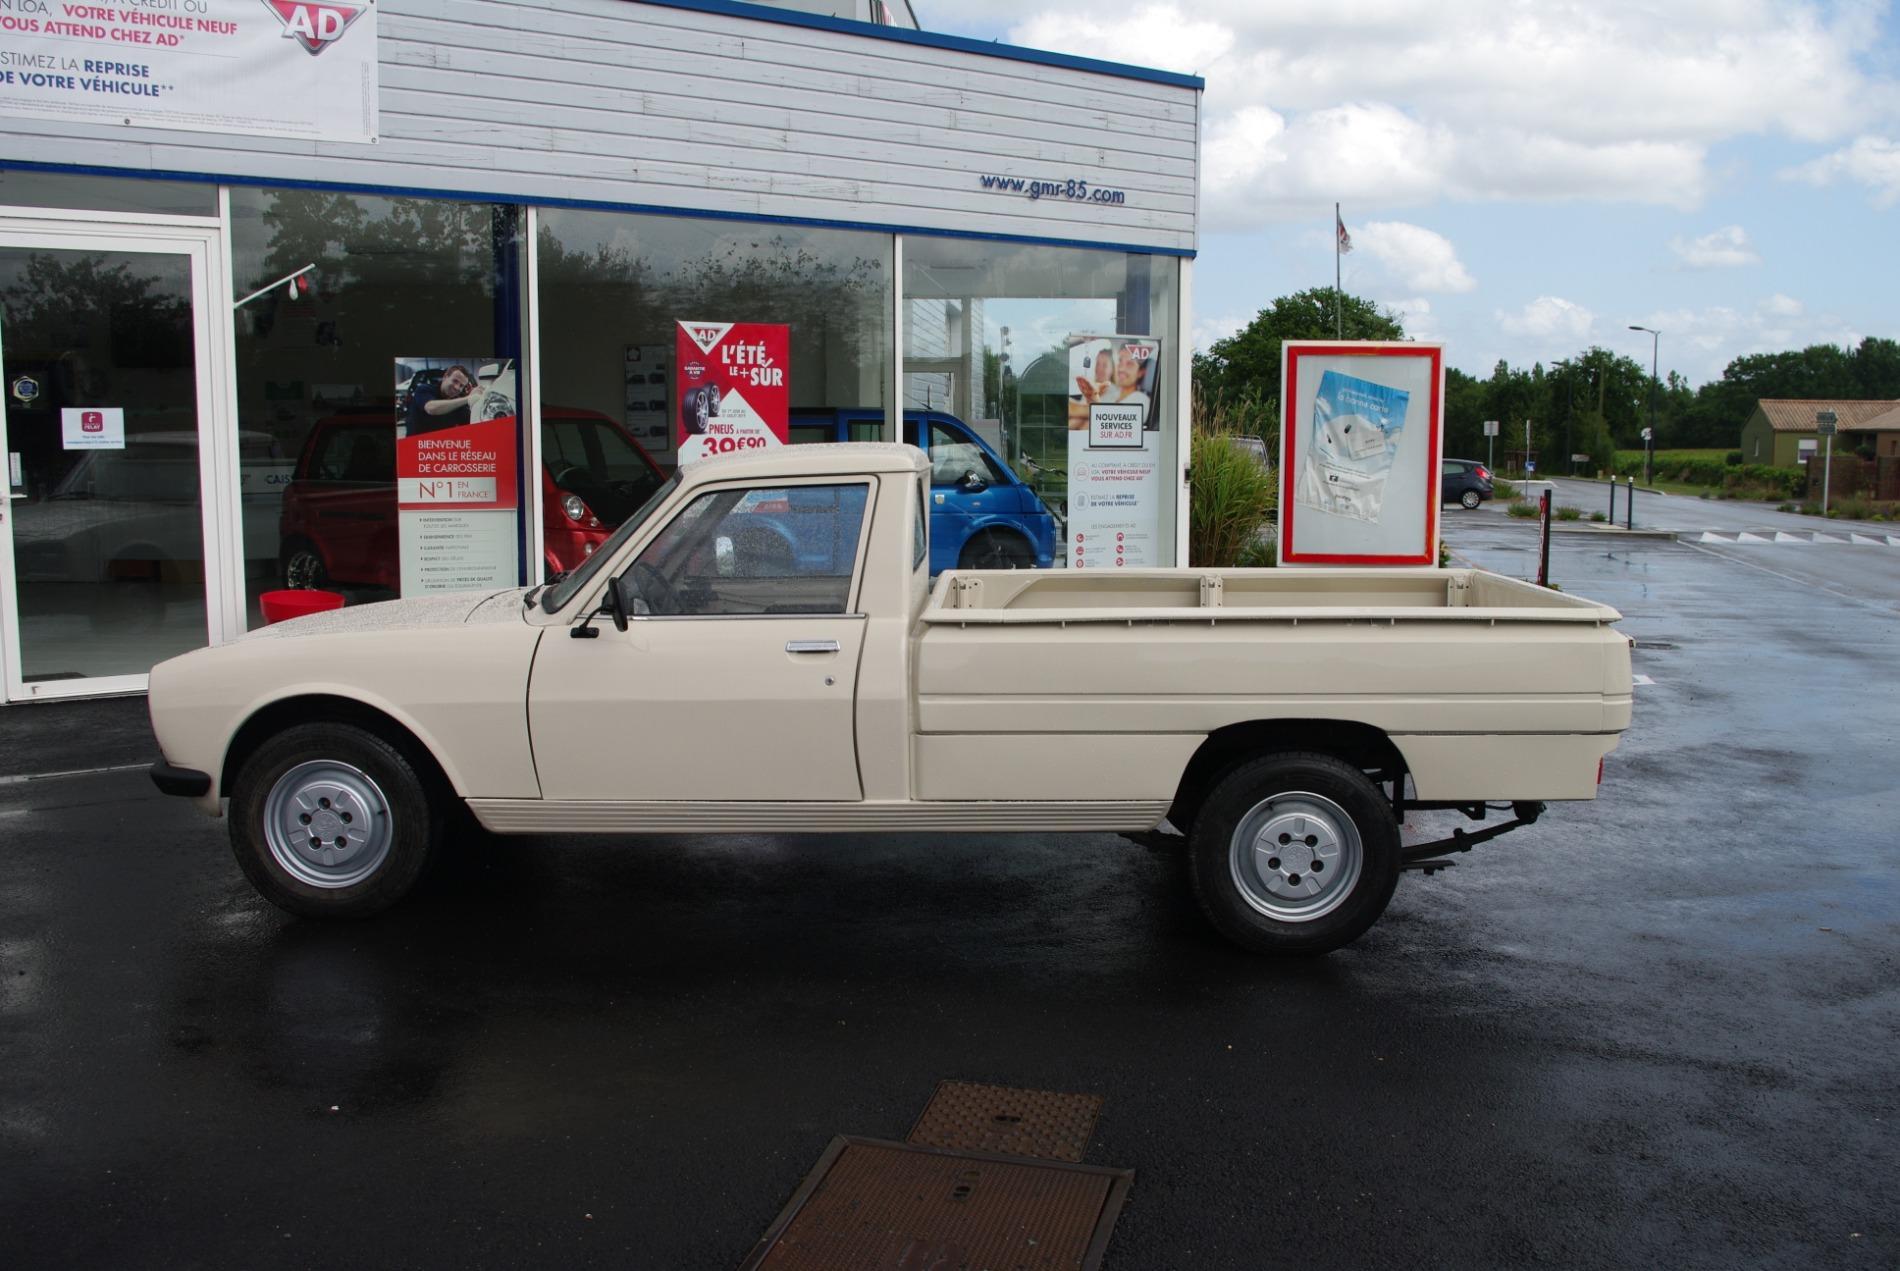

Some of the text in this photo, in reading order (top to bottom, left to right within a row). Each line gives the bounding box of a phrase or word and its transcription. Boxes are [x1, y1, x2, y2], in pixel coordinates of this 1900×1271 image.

[183, 0, 207, 14] OU
[18, 0, 52, 17] LOA,
[62, 3, 115, 21] VOTRE
[119, 8, 193, 30] VÉHICULE
[197, 18, 237, 34] NEUF
[282, 5, 344, 40] AD
[44, 20, 106, 39] ATTEND
[110, 28, 152, 44] CHEZ
[61, 57, 79, 71] LA
[84, 59, 149, 78] REPRISE
[19, 72, 75, 89] VOTRE
[980, 174, 1125, 203] www.gmr-85.com
[698, 330, 716, 341] AD
[722, 340, 766, 364] L'ÉTÉ
[1132, 347, 1150, 360] AD
[729, 366, 738, 376] LE
[1095, 413, 1137, 421] NOUVEAUX
[709, 424, 734, 434] PNEUS
[1100, 422, 1133, 430] SERVICES
[1100, 430, 1112, 438] SUR
[418, 440, 471, 449] BIENVENUE
[418, 449, 496, 461] DANS LE RÉSEAU
[418, 463, 496, 472] DE CARROSSERIE
[457, 481, 469, 489] EN
[458, 490, 488, 498] FRANCE
